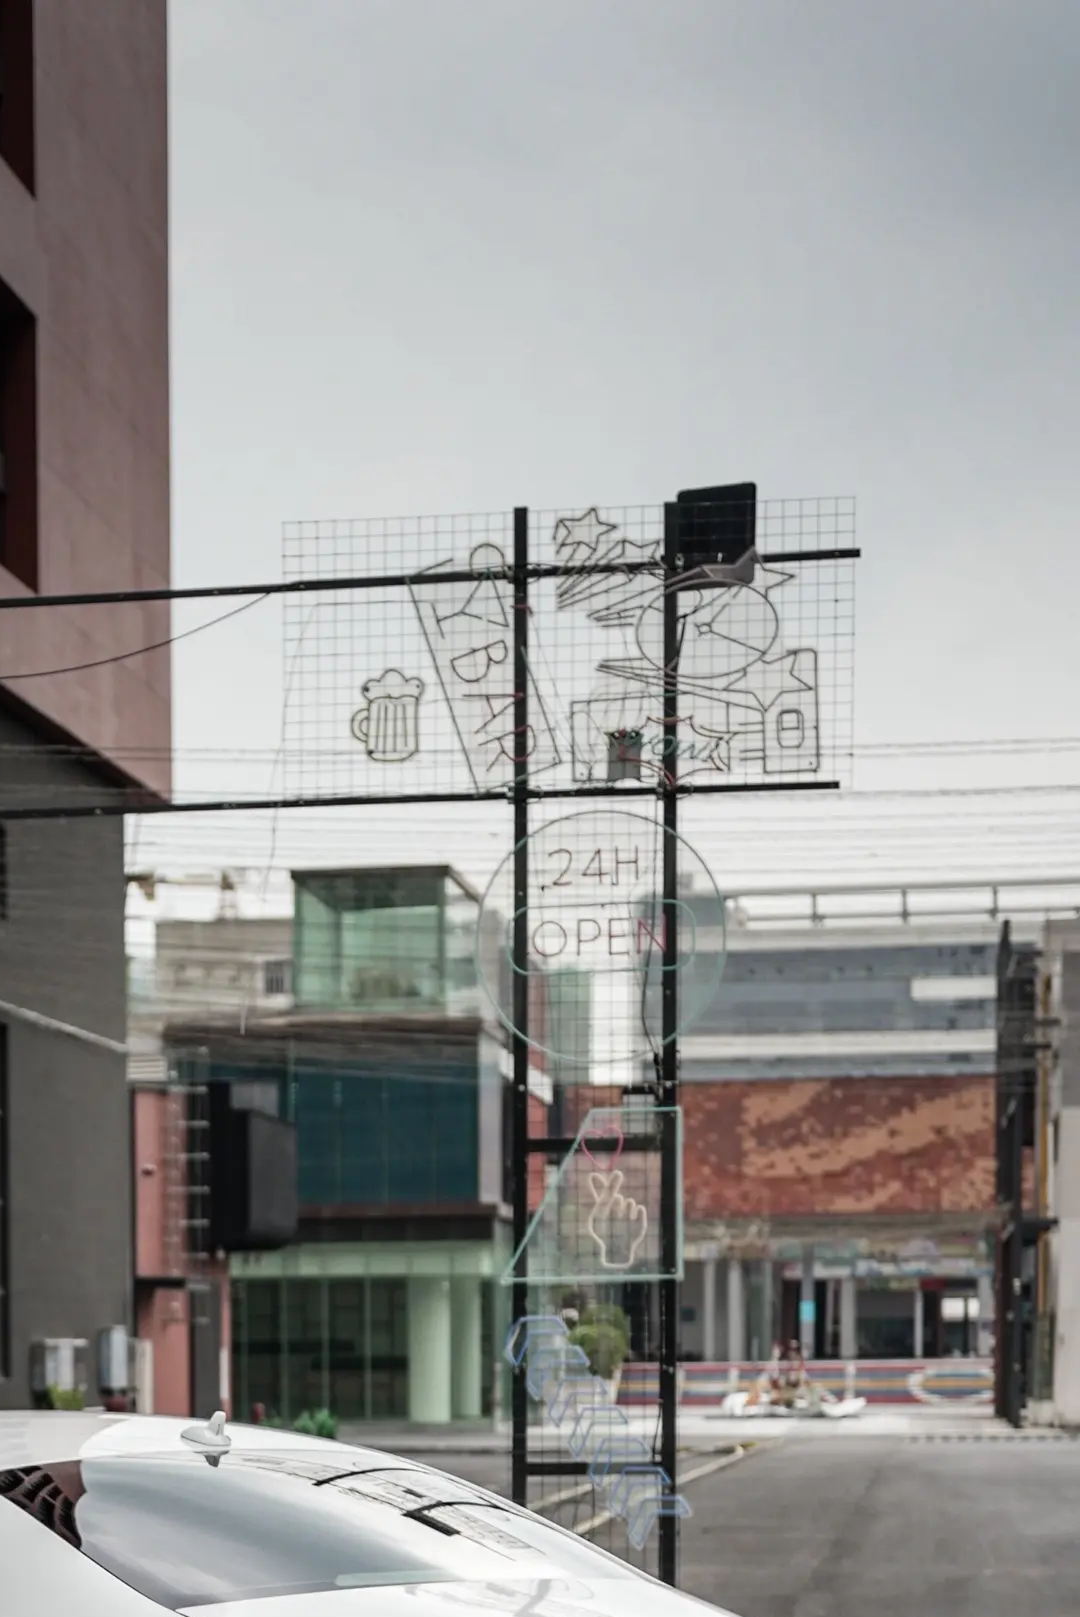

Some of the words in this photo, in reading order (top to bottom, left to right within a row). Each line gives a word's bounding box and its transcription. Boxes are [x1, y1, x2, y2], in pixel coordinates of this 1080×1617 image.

[450, 639, 537, 773] BAR
[547, 845, 639, 886] 24H
[532, 911, 667, 957] OPEN
